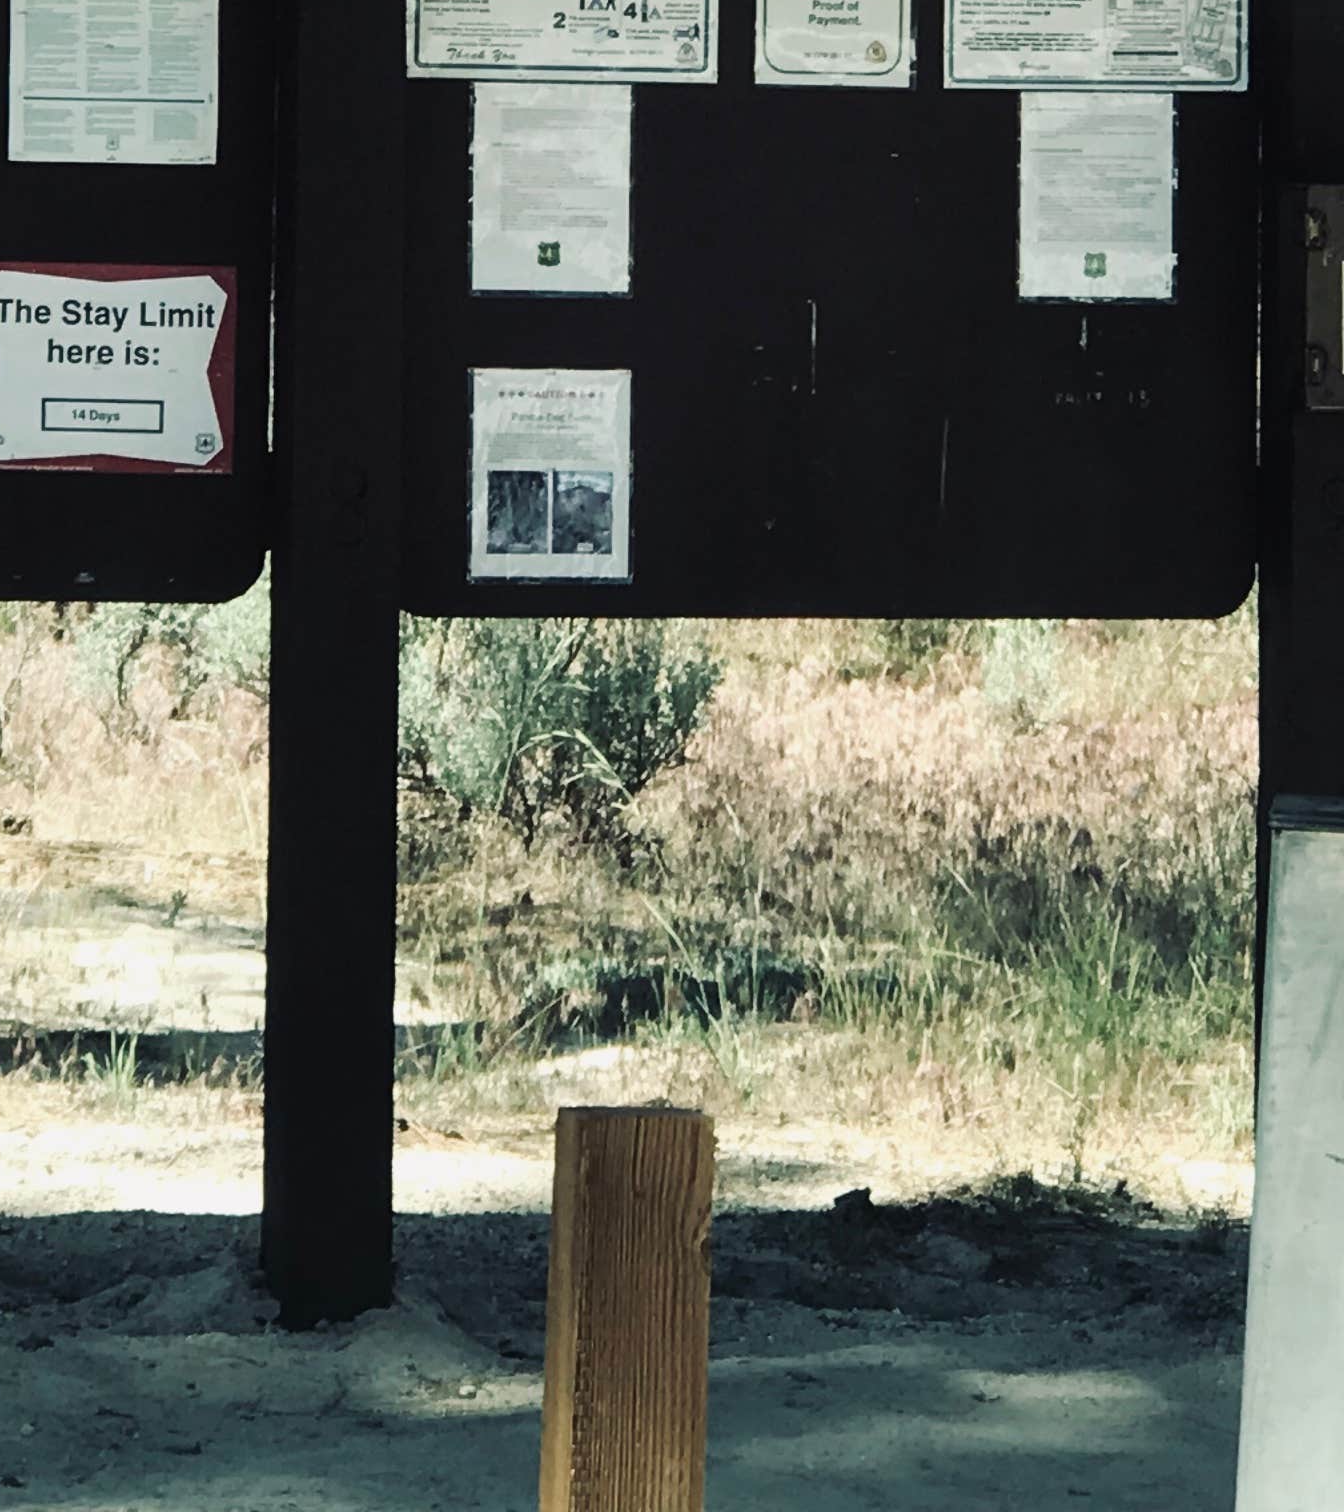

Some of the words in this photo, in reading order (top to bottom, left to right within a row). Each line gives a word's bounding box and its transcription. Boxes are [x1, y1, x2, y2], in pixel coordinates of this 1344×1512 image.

[624, 3, 637, 19] 4
[813, 0, 844, 10] Proof
[553, 12, 566, 29] 2
[61, 300, 128, 332] Stay
[139, 302, 215, 328] Limit
[47, 338, 113, 365] here
[125, 340, 160, 366] is:
[72, 409, 85, 421] 14
[89, 410, 120, 424] Days
